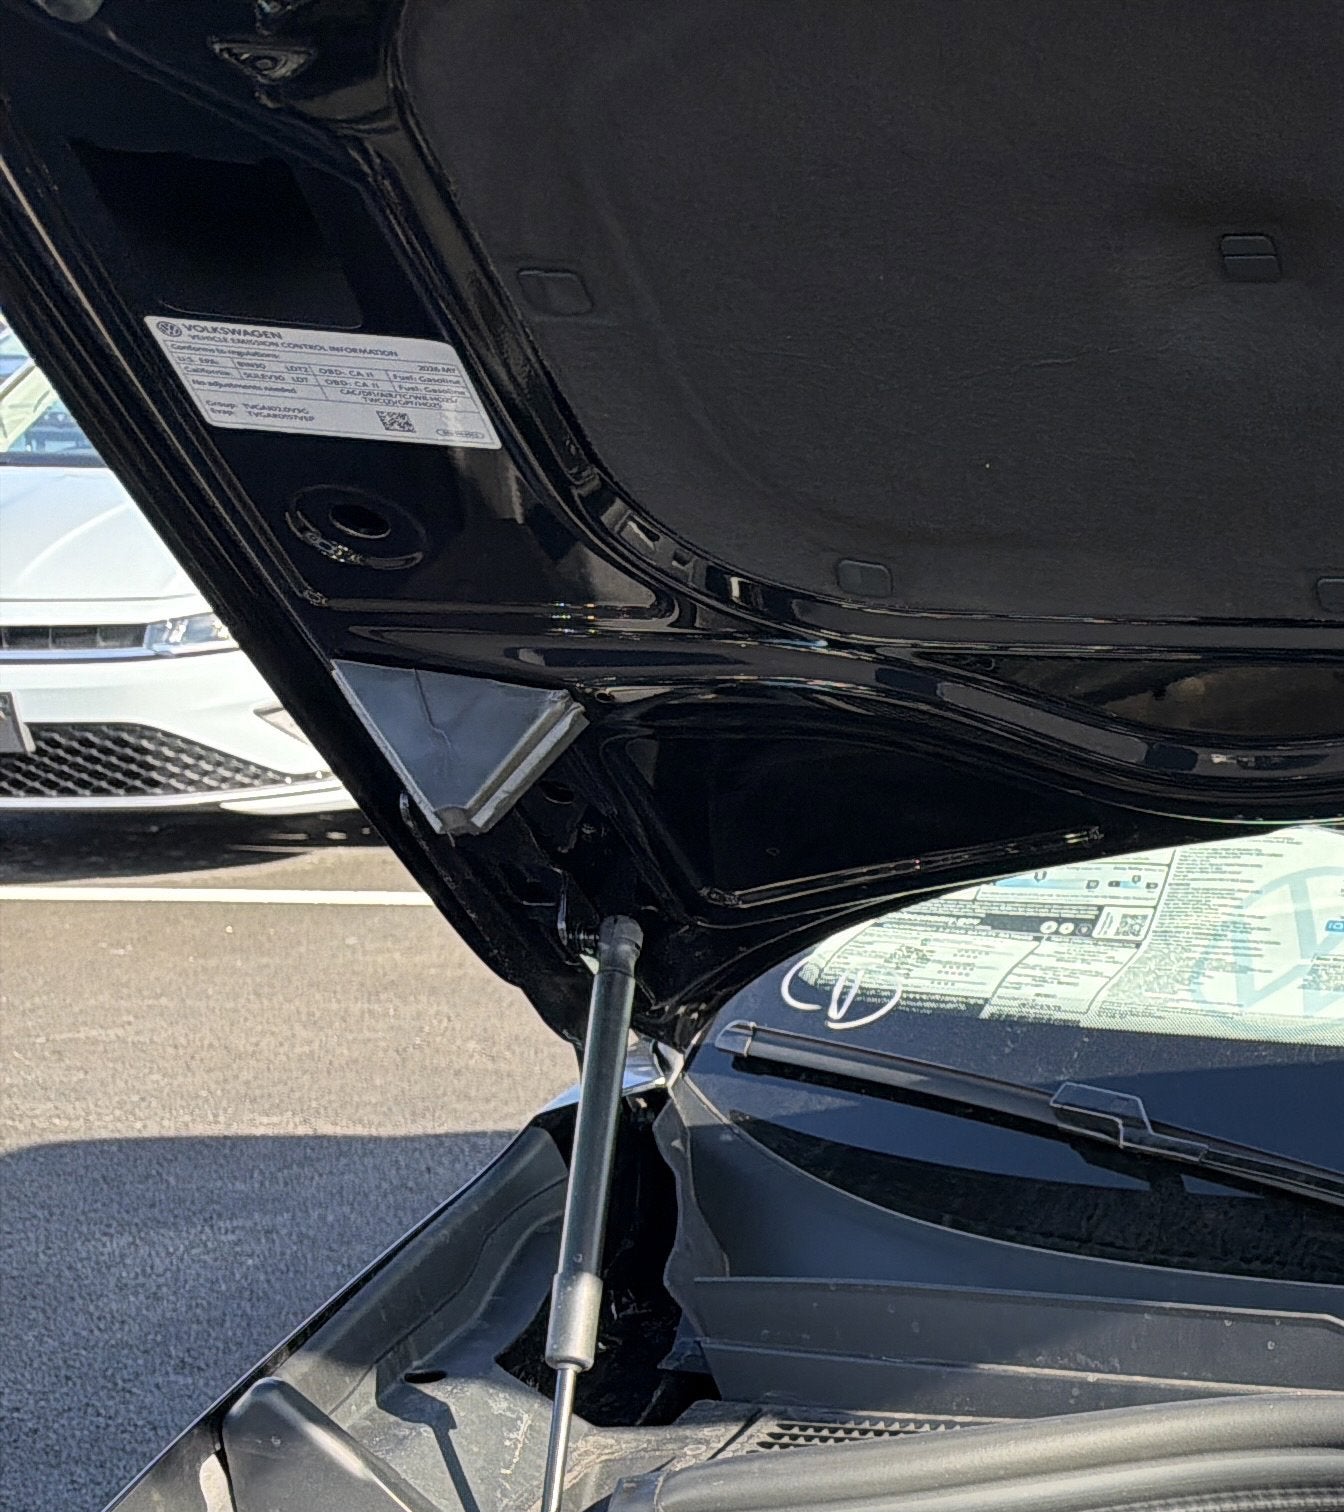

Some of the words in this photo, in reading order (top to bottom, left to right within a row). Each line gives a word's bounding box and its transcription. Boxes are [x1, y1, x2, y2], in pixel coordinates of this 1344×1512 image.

[182, 323, 283, 340] VOLKSWAGEN
[280, 341, 327, 351] CONTROL
[328, 346, 398, 356] INFORMATION
[418, 376, 461, 384] Gasoline
[424, 386, 466, 396] Gasoline
